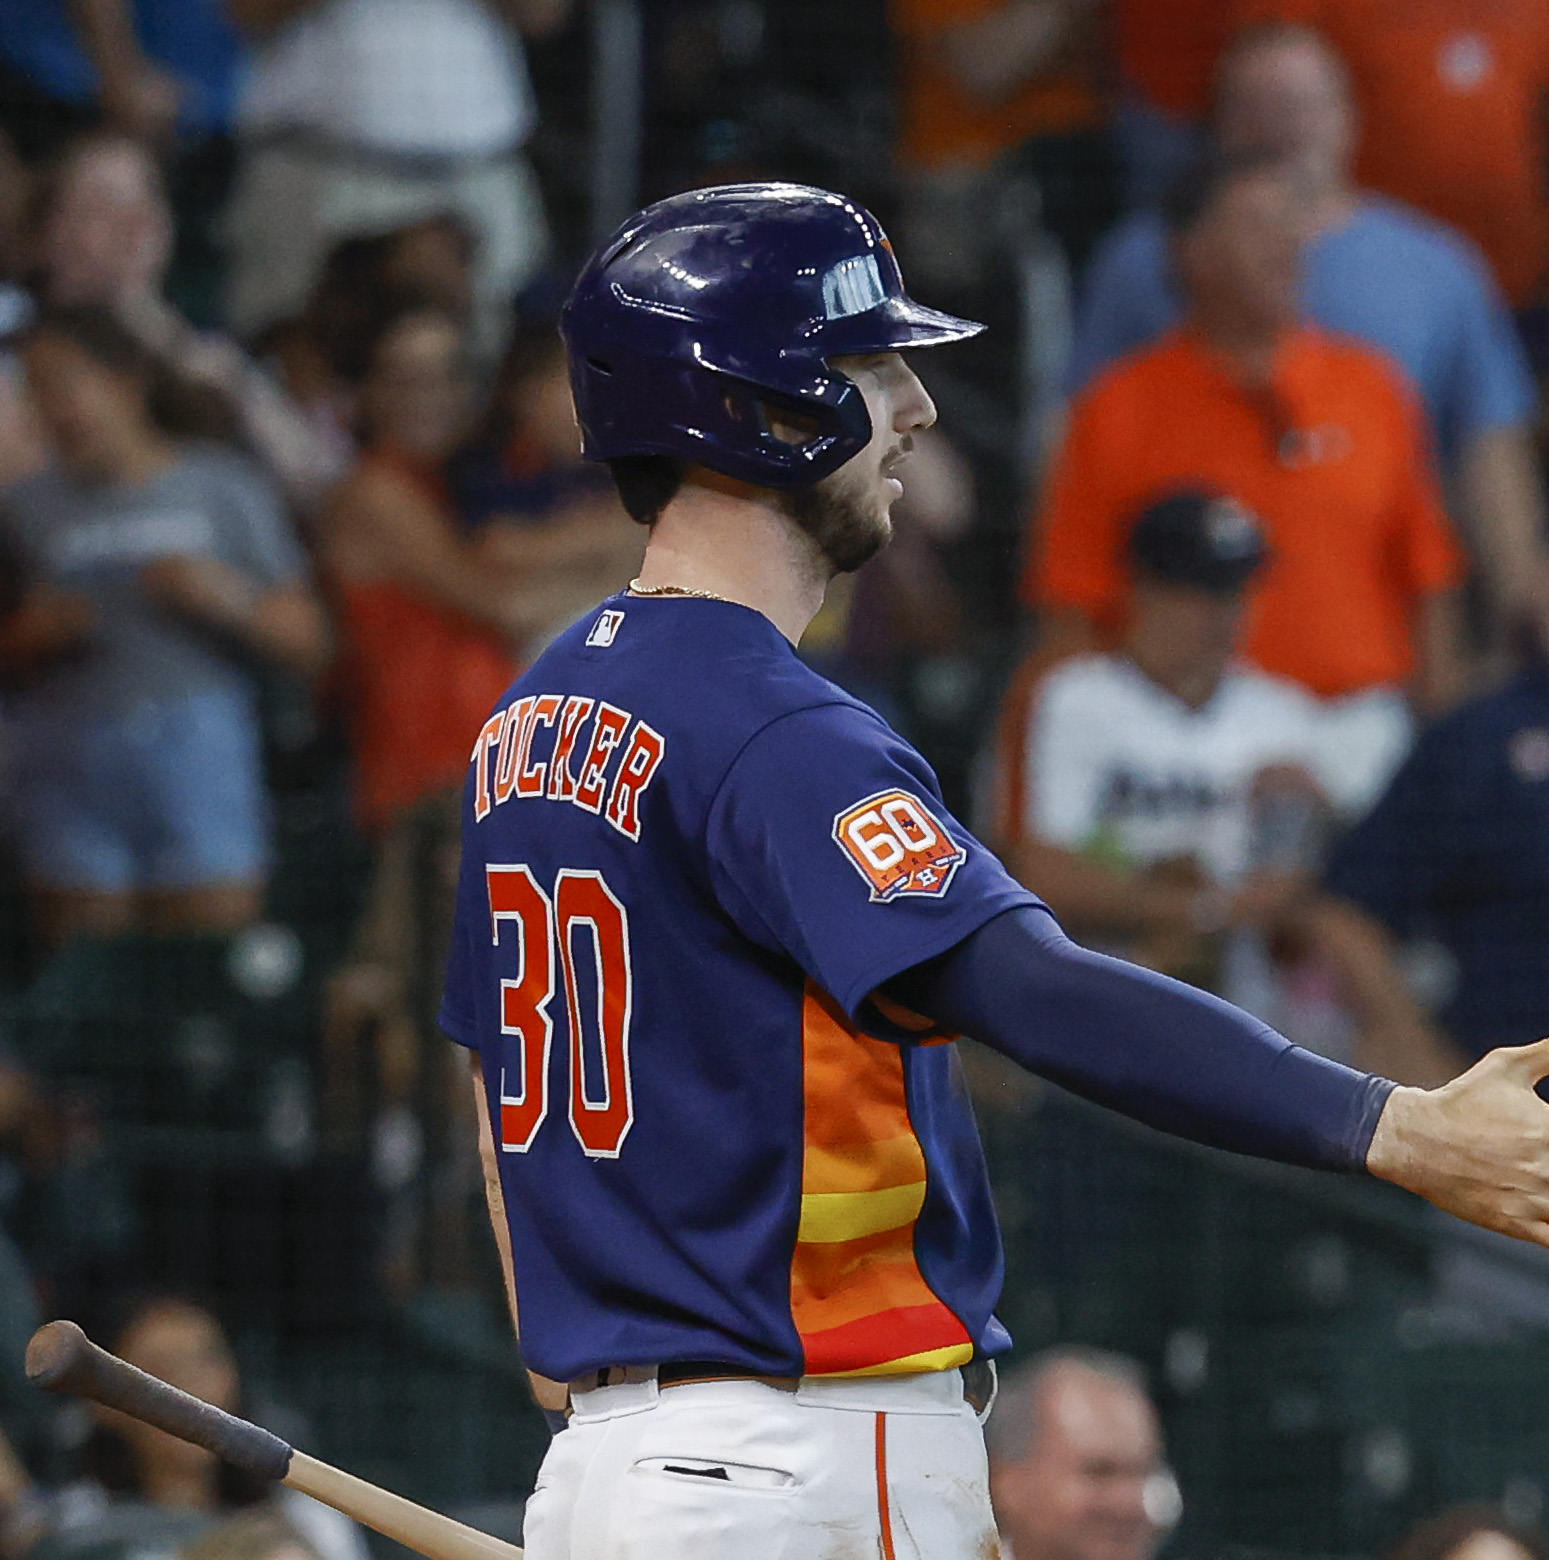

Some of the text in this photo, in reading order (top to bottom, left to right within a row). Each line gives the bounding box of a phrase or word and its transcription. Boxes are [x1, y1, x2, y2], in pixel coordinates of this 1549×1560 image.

[469, 695, 666, 844] TUCKER
[847, 799, 937, 871] 60
[486, 863, 634, 1159] 30
